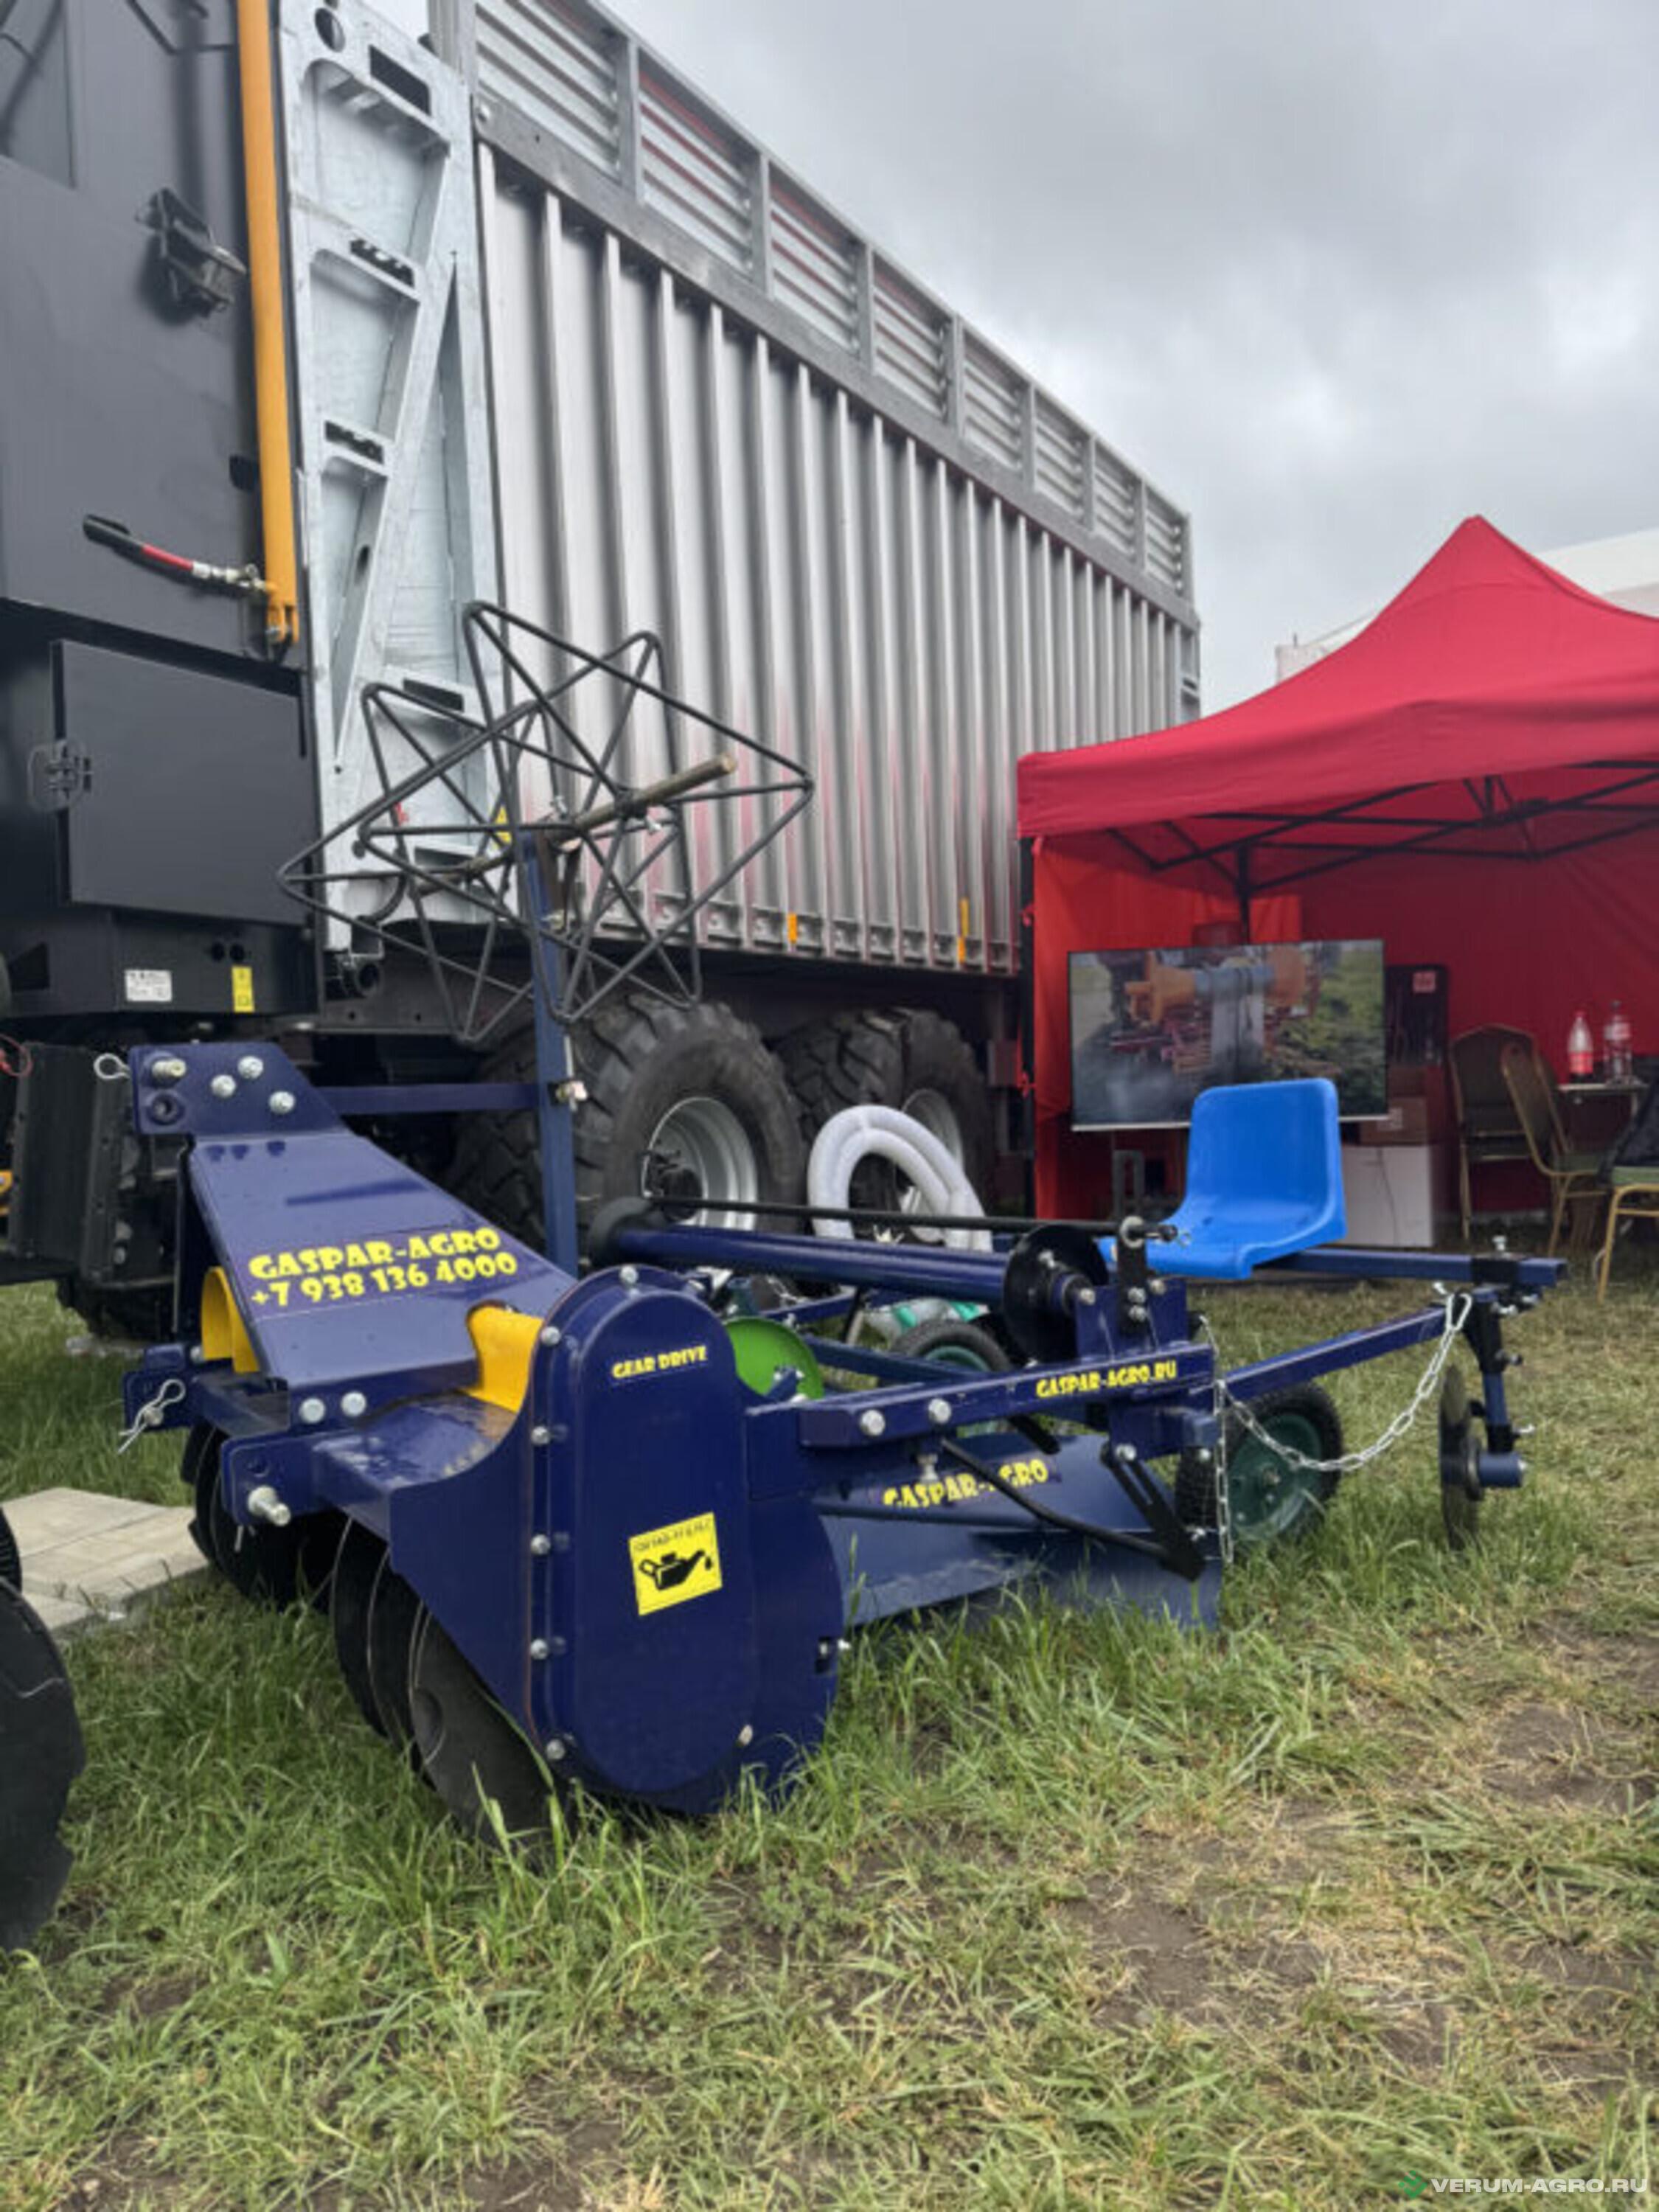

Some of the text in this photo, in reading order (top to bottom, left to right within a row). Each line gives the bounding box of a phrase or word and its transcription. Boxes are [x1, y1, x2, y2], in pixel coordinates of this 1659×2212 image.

[248, 1228, 500, 1279] GASPAR-AGRO
[251, 1253, 518, 1307] +7 938 136 4000
[613, 1345, 707, 1378] GEAR DRIVE
[1036, 1360, 1177, 1398] GASPAR-AGRO.RU
[883, 1458, 1048, 1509] GASPAR-GRO
